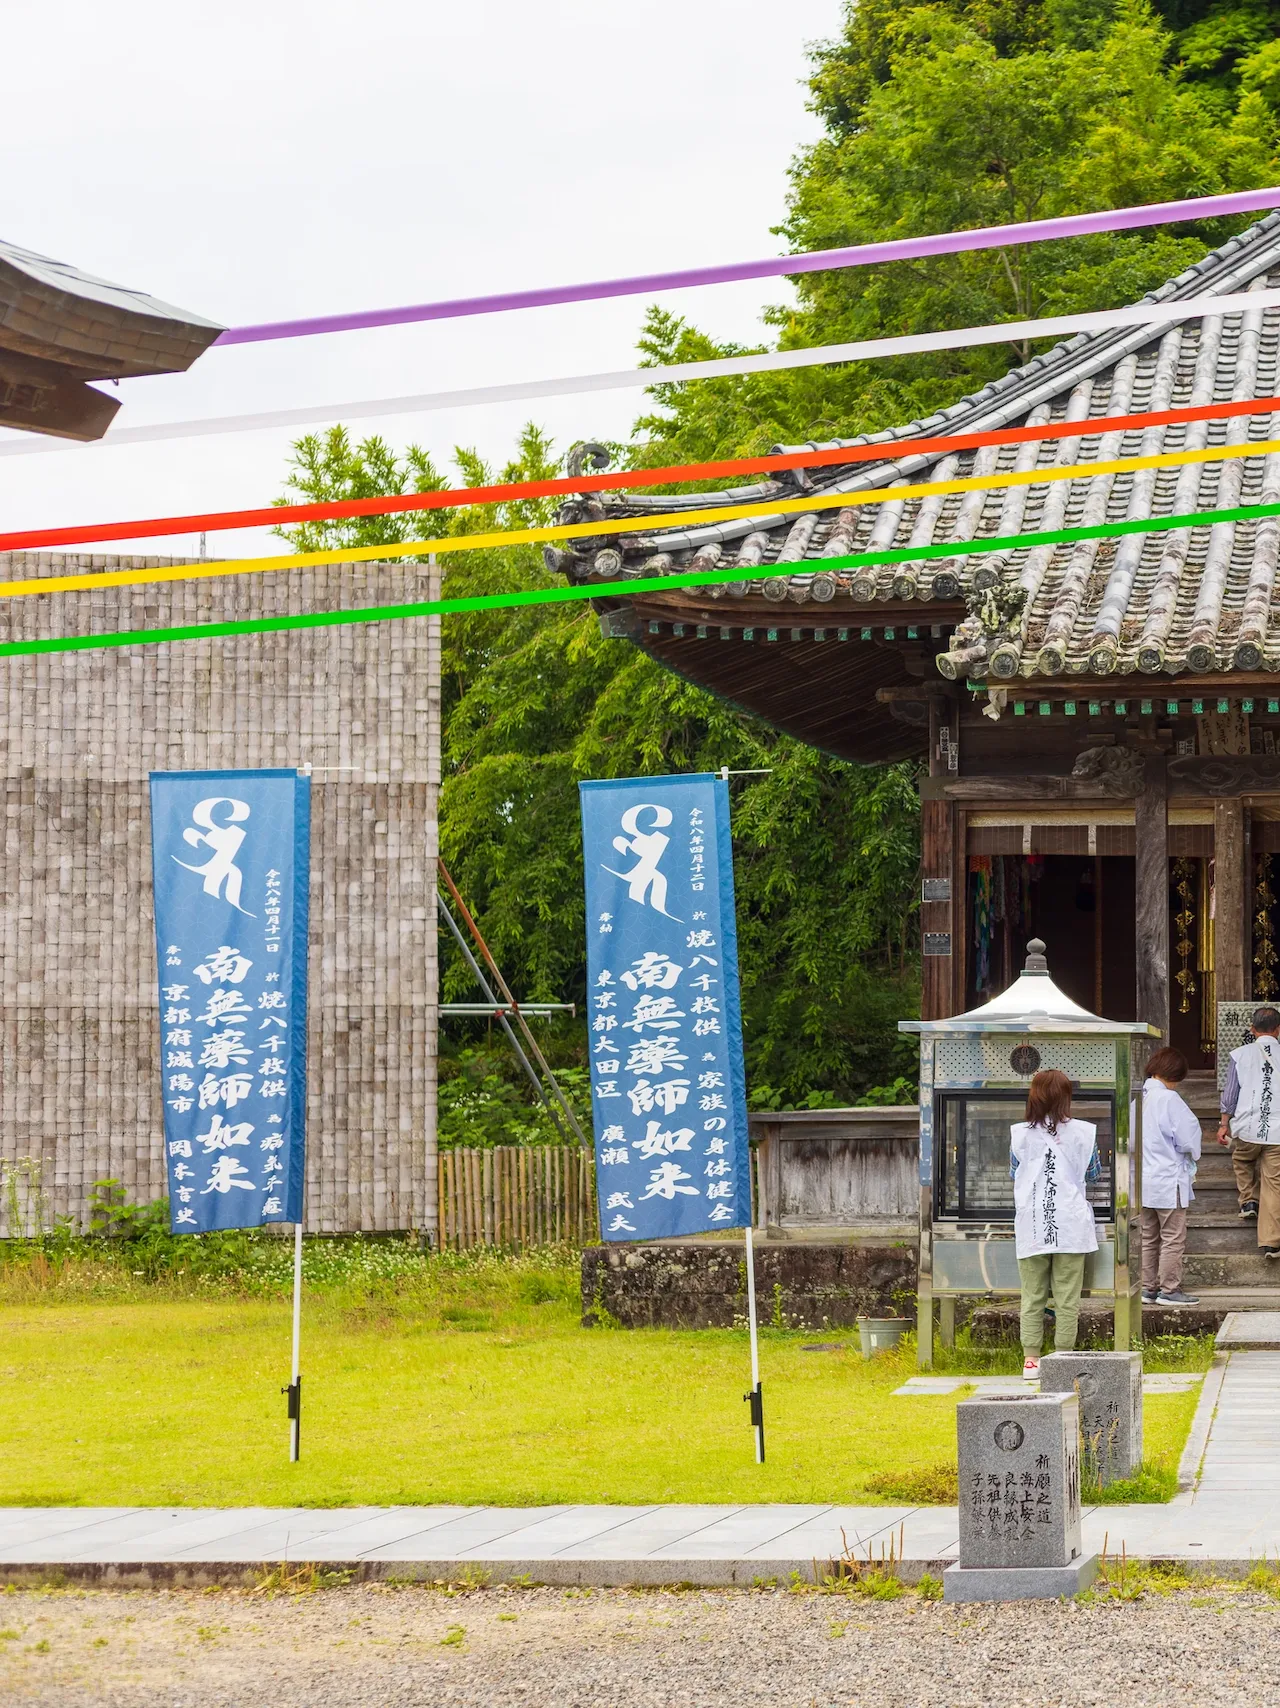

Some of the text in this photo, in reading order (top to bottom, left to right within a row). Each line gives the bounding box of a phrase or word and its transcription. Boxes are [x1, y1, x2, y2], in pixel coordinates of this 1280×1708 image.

[163, 984, 195, 1114] 京都府城陽市
[593, 969, 622, 1098] 東京都大田区
